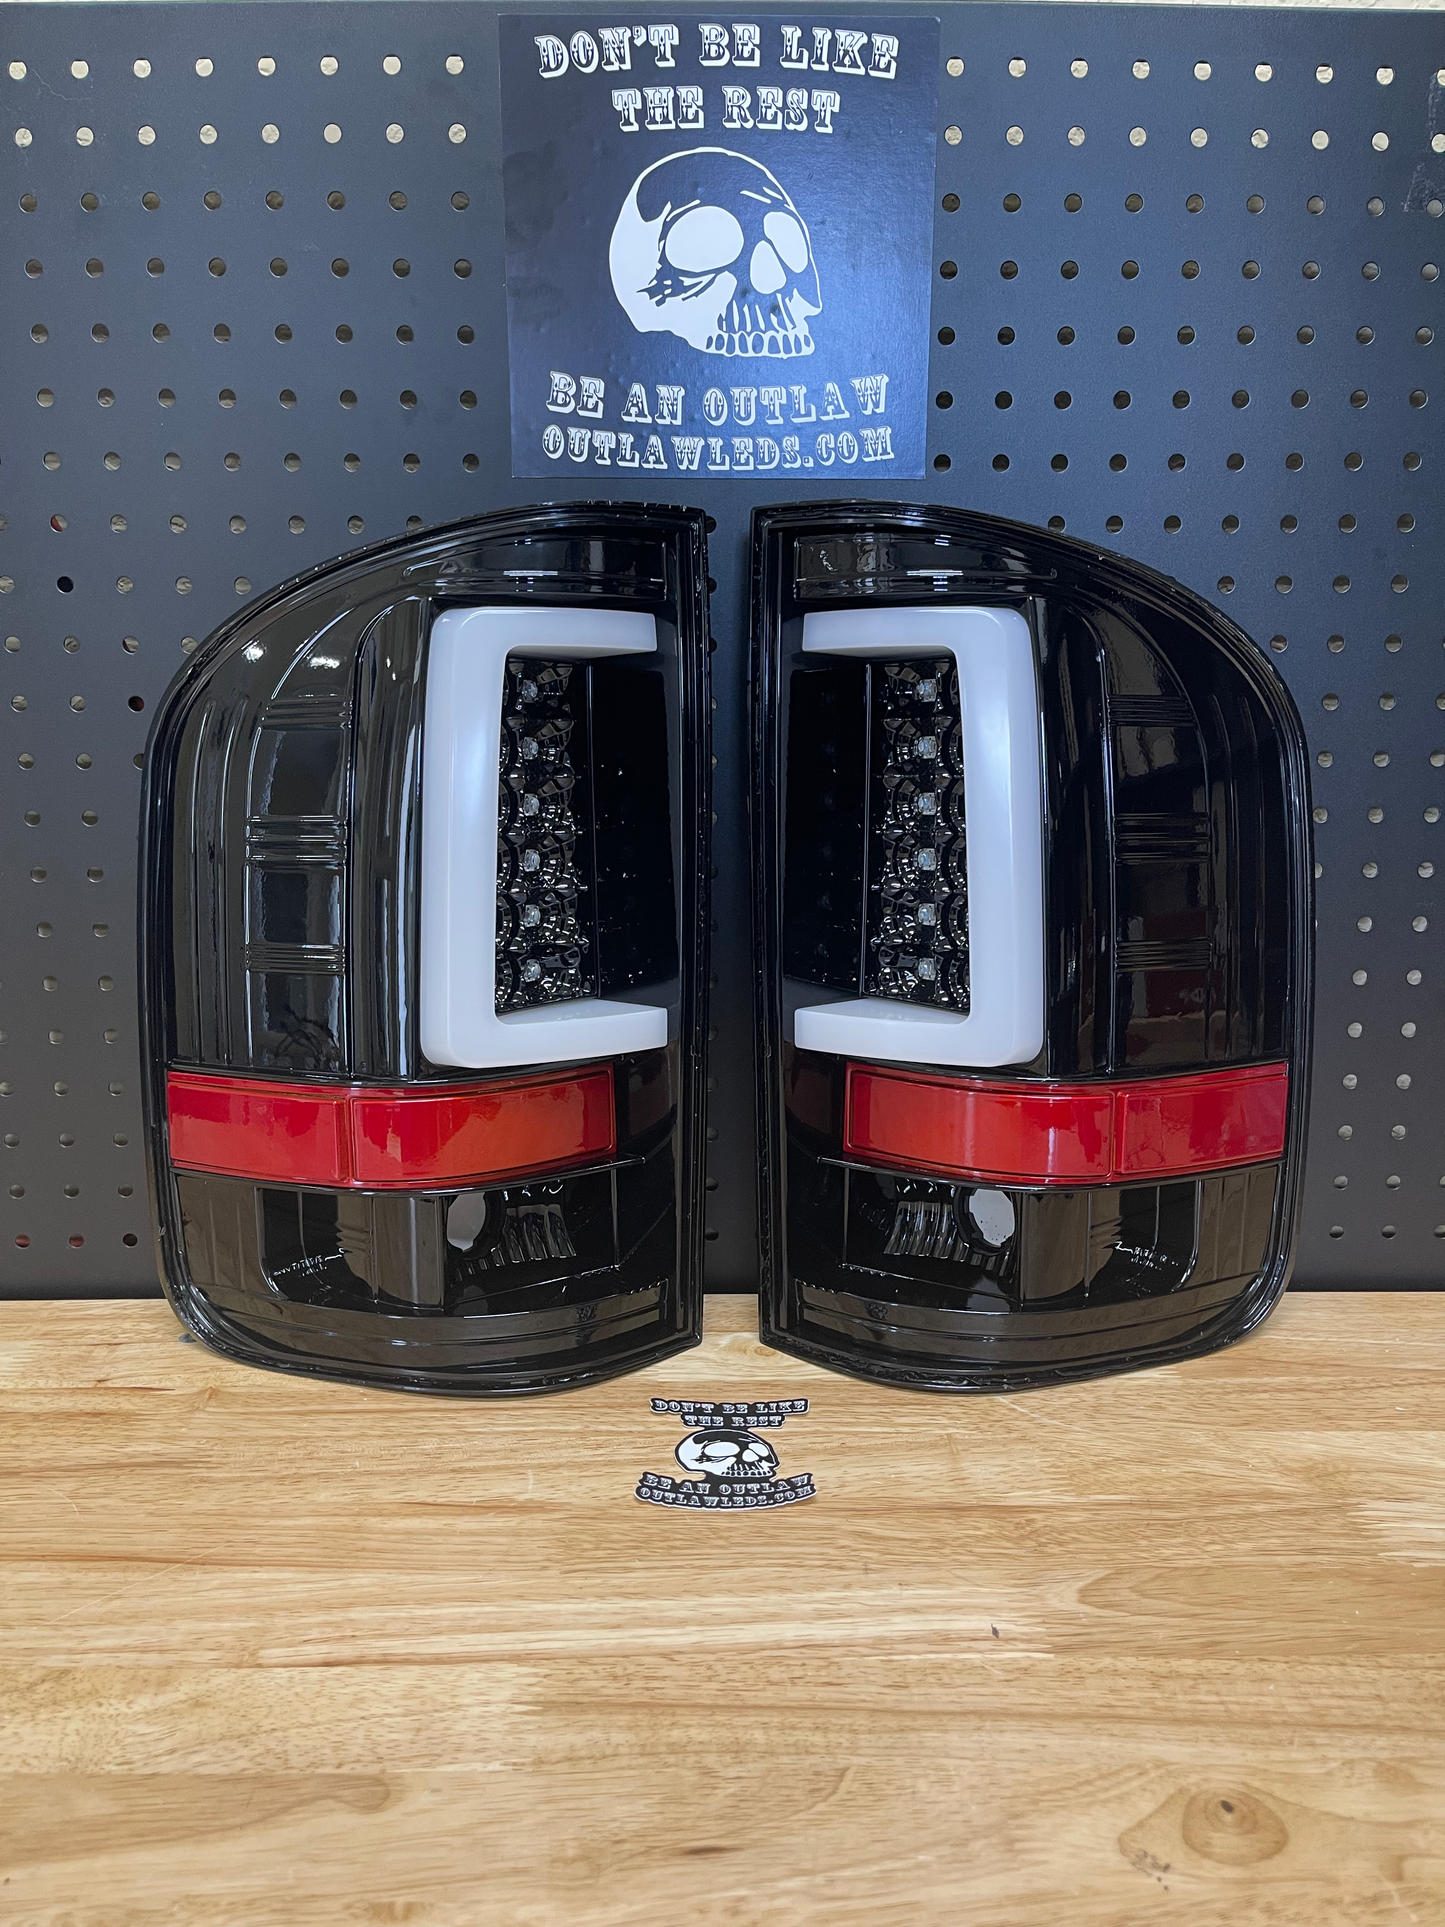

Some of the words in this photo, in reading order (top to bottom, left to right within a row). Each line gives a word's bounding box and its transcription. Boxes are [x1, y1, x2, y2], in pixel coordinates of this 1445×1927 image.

[534, 25, 679, 79] DON'T
[699, 23, 761, 67] BE
[780, 25, 900, 79] LIKE
[611, 86, 705, 133] THE
[722, 86, 841, 134] REST
[546, 371, 604, 418] BE
[621, 383, 686, 426] AN
[702, 374, 889, 426] OUTLAW
[541, 424, 895, 471] OUTLAWLEDS.COM
[654, 1399, 714, 1413] DON'T
[722, 1403, 748, 1413] BE
[755, 1400, 806, 1413] LIKE
[684, 1415, 724, 1426] THE
[731, 1415, 782, 1426] REST
[643, 1474, 672, 1490] BE
[679, 1481, 711, 1495] AN
[719, 1475, 808, 1495] OUTLAW
